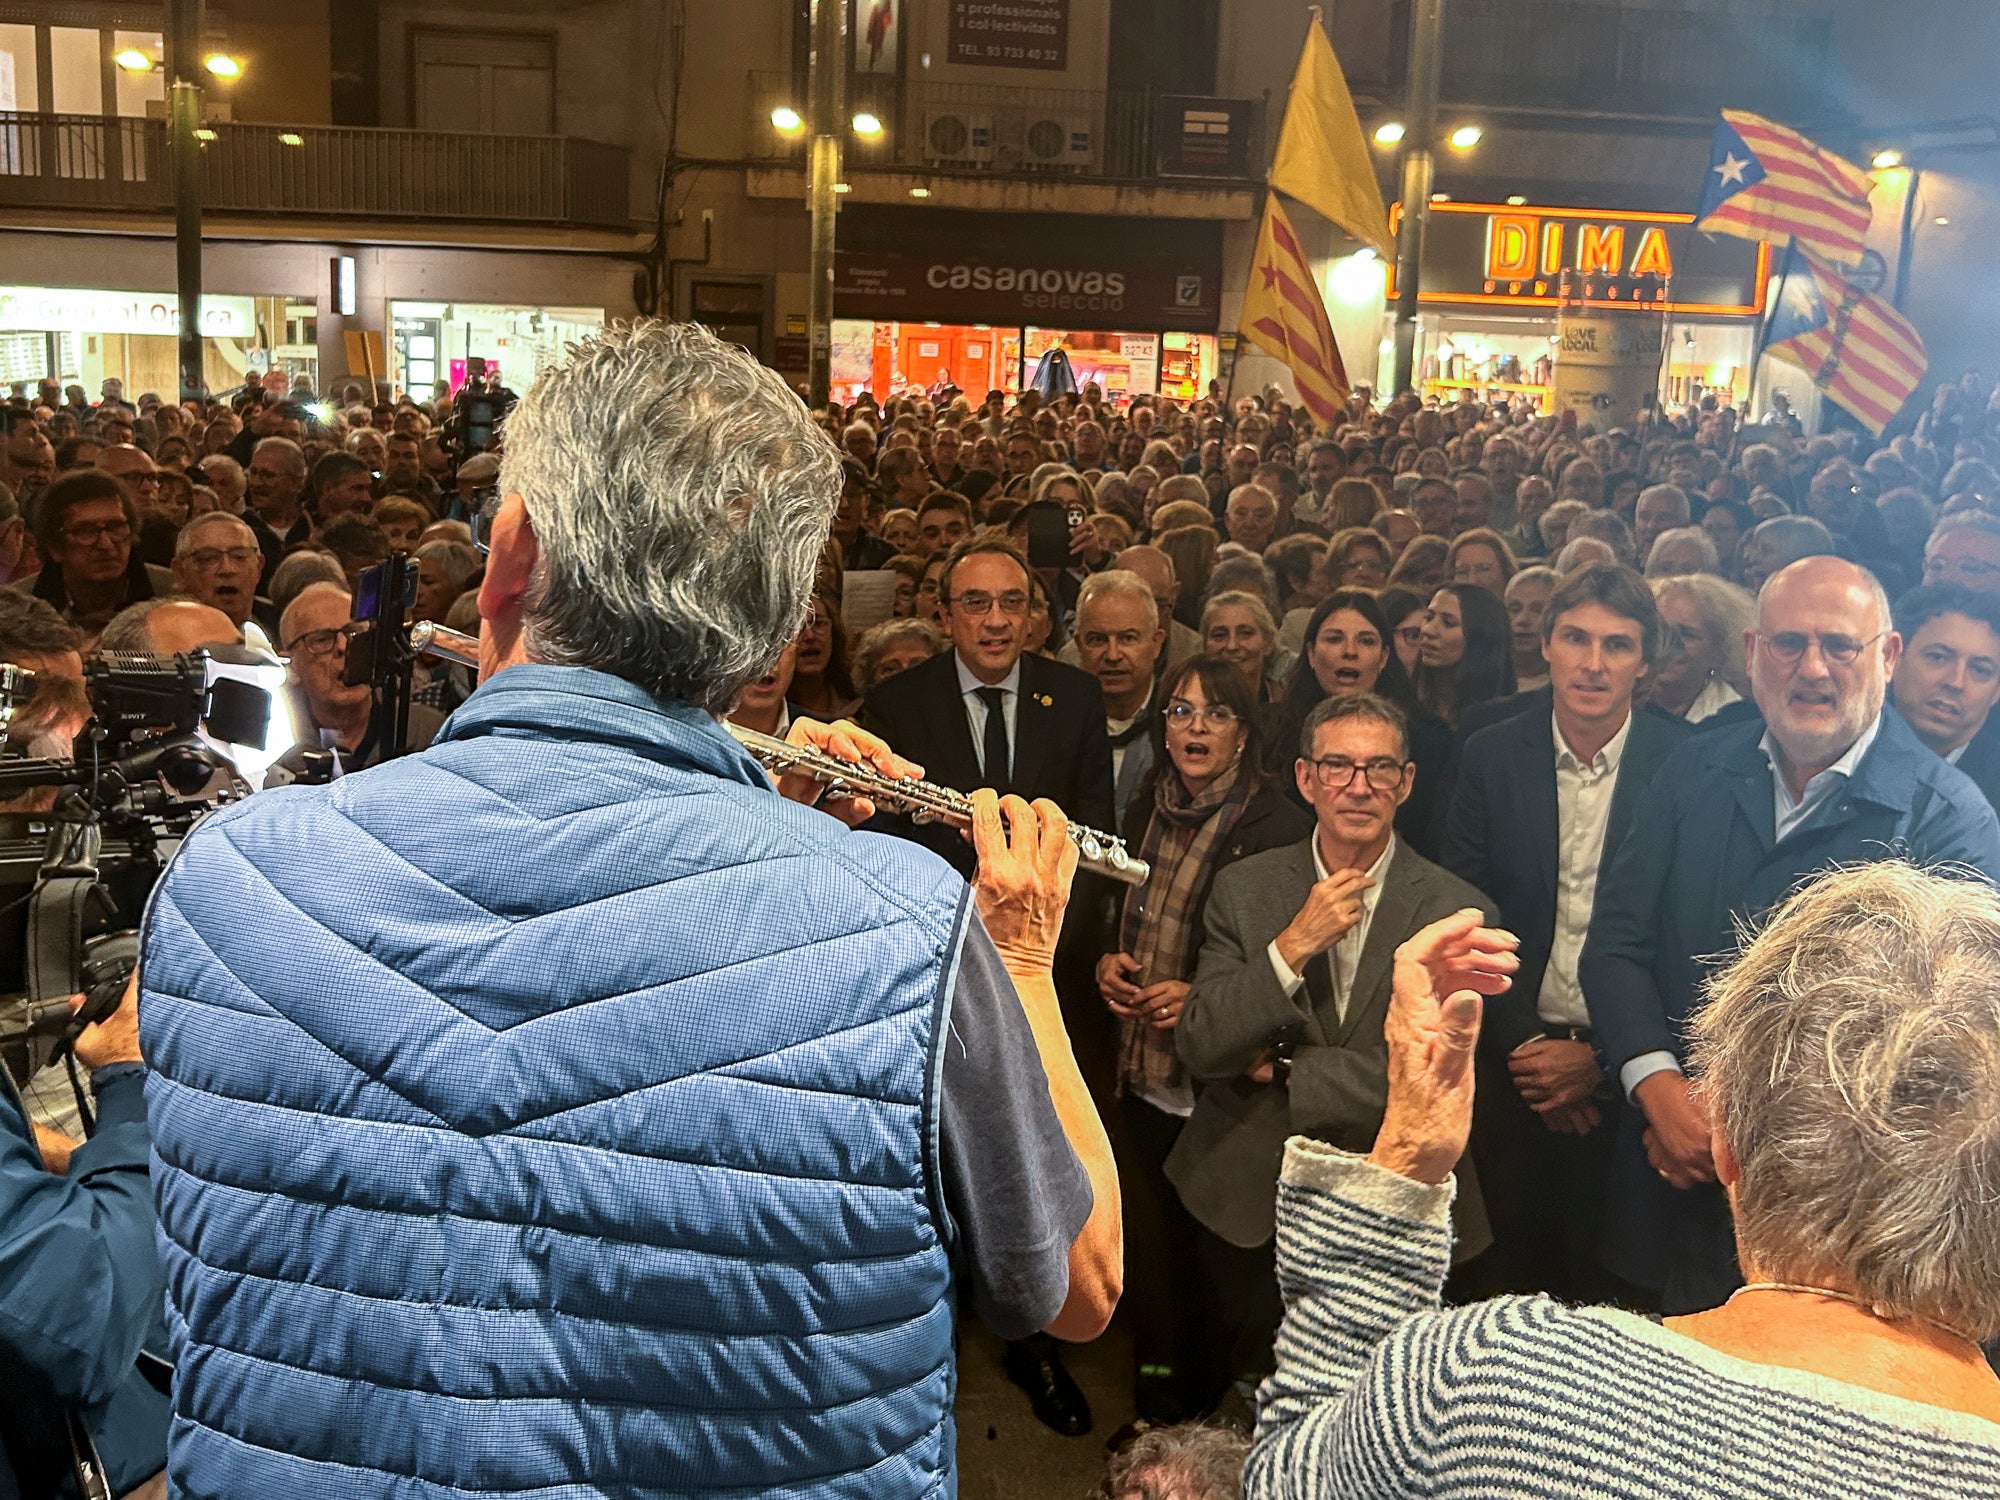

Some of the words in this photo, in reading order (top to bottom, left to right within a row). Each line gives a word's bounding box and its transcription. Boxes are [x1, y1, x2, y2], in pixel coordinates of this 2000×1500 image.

[957, 4, 965, 13] a
[968, 4, 1060, 20] professionals
[1004, 47, 1025, 59] 733
[1044, 50, 1058, 61] 32
[1484, 214, 1672, 280] DIMA
[926, 264, 1126, 297] casanovas
[1565, 325, 1597, 340] LOVE
[1561, 339, 1598, 353] LOCAL
